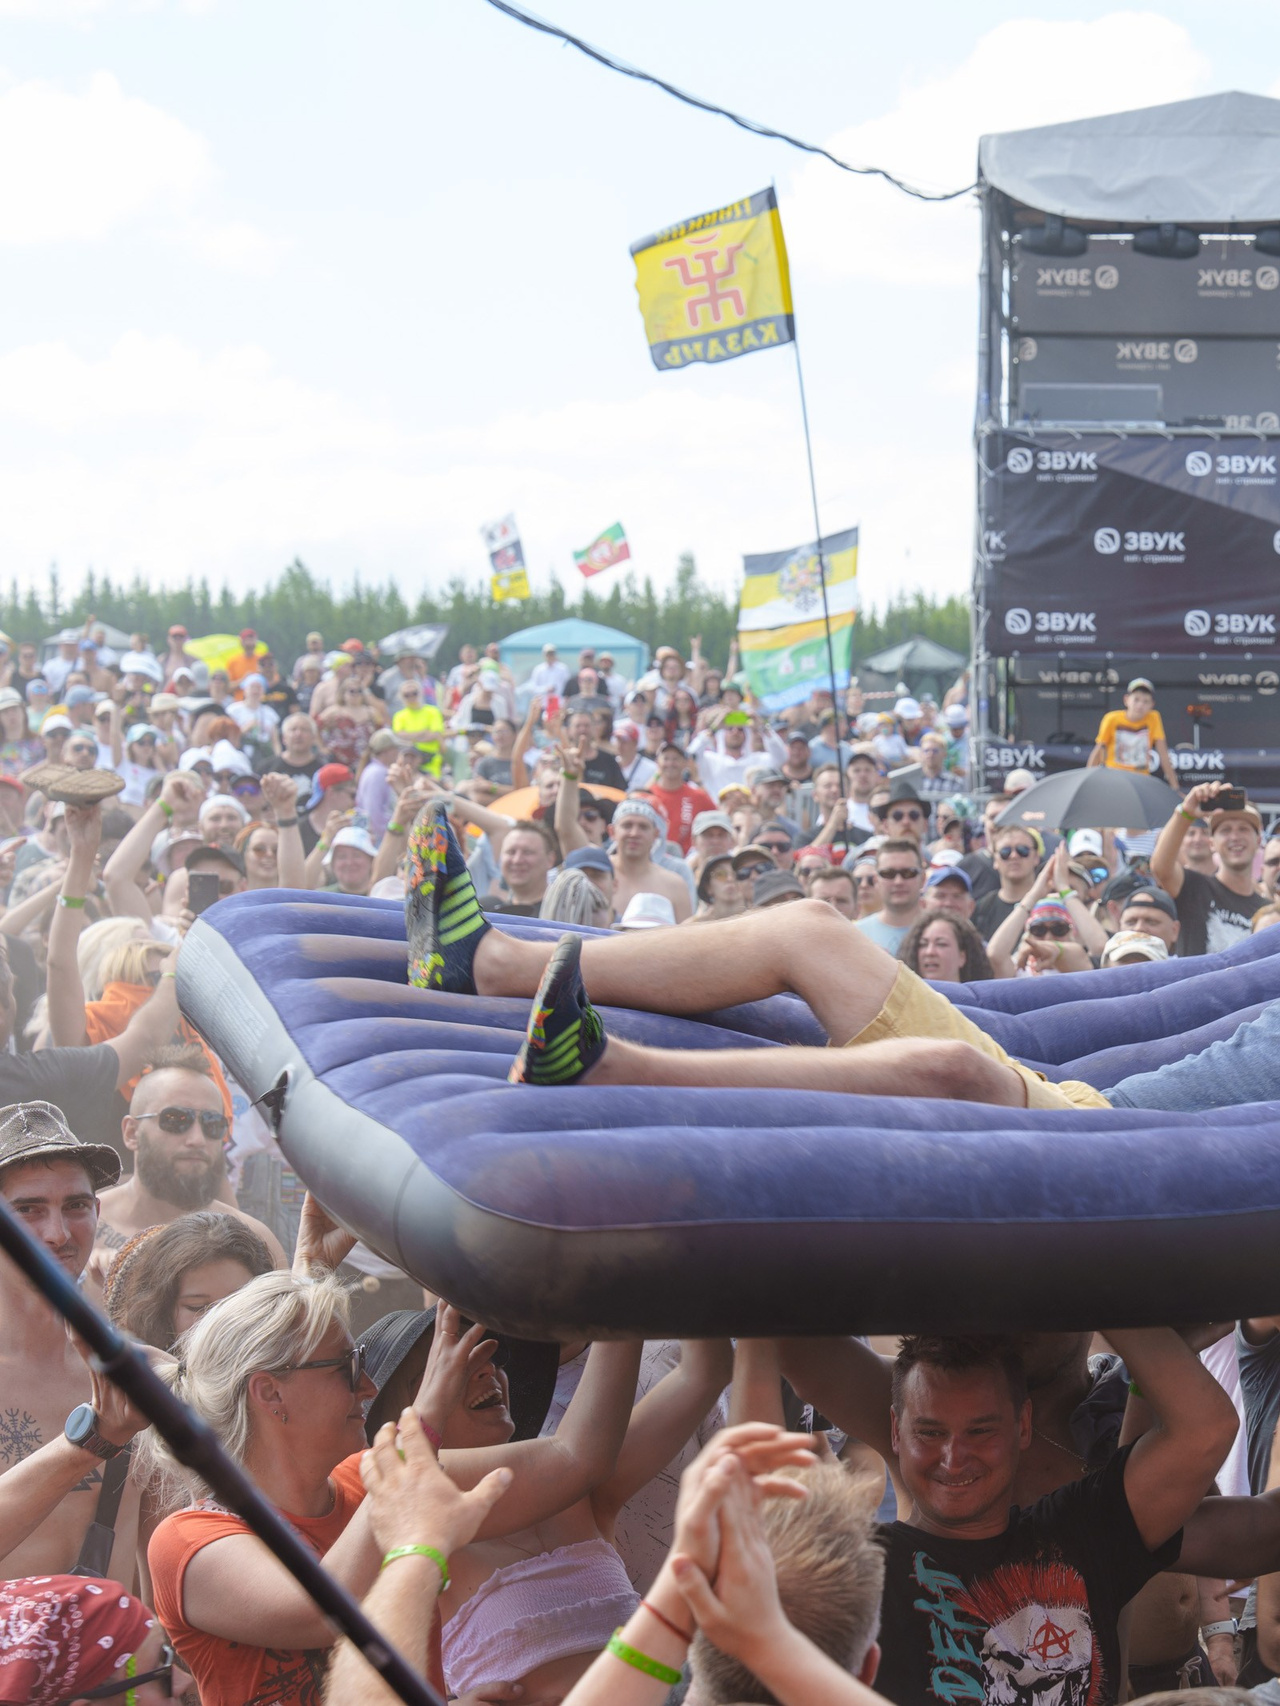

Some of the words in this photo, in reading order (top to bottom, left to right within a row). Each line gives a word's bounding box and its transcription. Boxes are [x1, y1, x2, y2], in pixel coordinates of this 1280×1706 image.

[1036, 451, 1098, 470] ЗВУК
[1216, 455, 1277, 474] ЗВУК
[1124, 531, 1186, 551] ЗВУК
[1035, 612, 1097, 632] ЗВУК
[1214, 614, 1276, 633] ЗВУК
[985, 747, 1046, 768] ЗВУК
